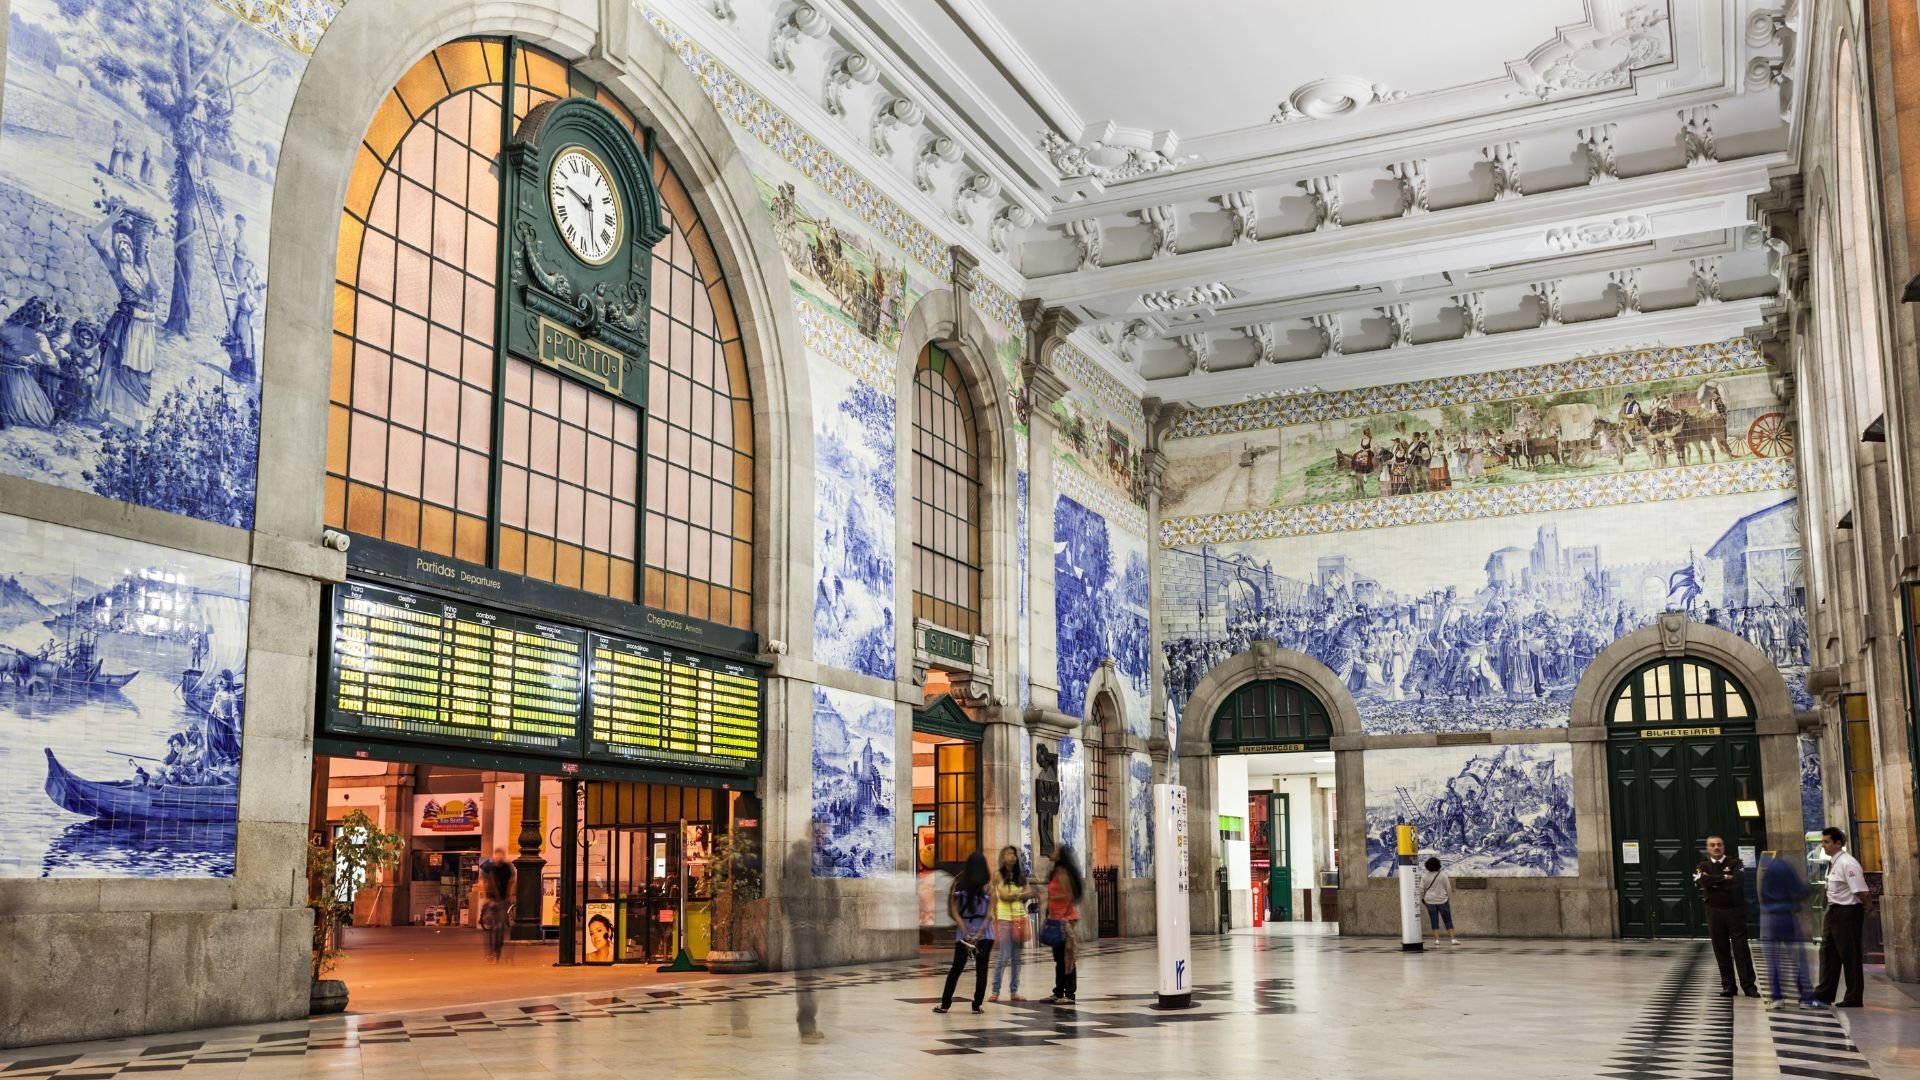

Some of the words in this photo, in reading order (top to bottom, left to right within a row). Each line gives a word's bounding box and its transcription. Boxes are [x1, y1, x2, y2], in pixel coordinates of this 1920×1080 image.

[554, 331, 610, 377] PORTO
[416, 557, 456, 578] Partidas
[460, 570, 501, 589] Departures
[647, 612, 682, 629] Chegadas
[1646, 728, 1715, 737] BILHETEIRAS
